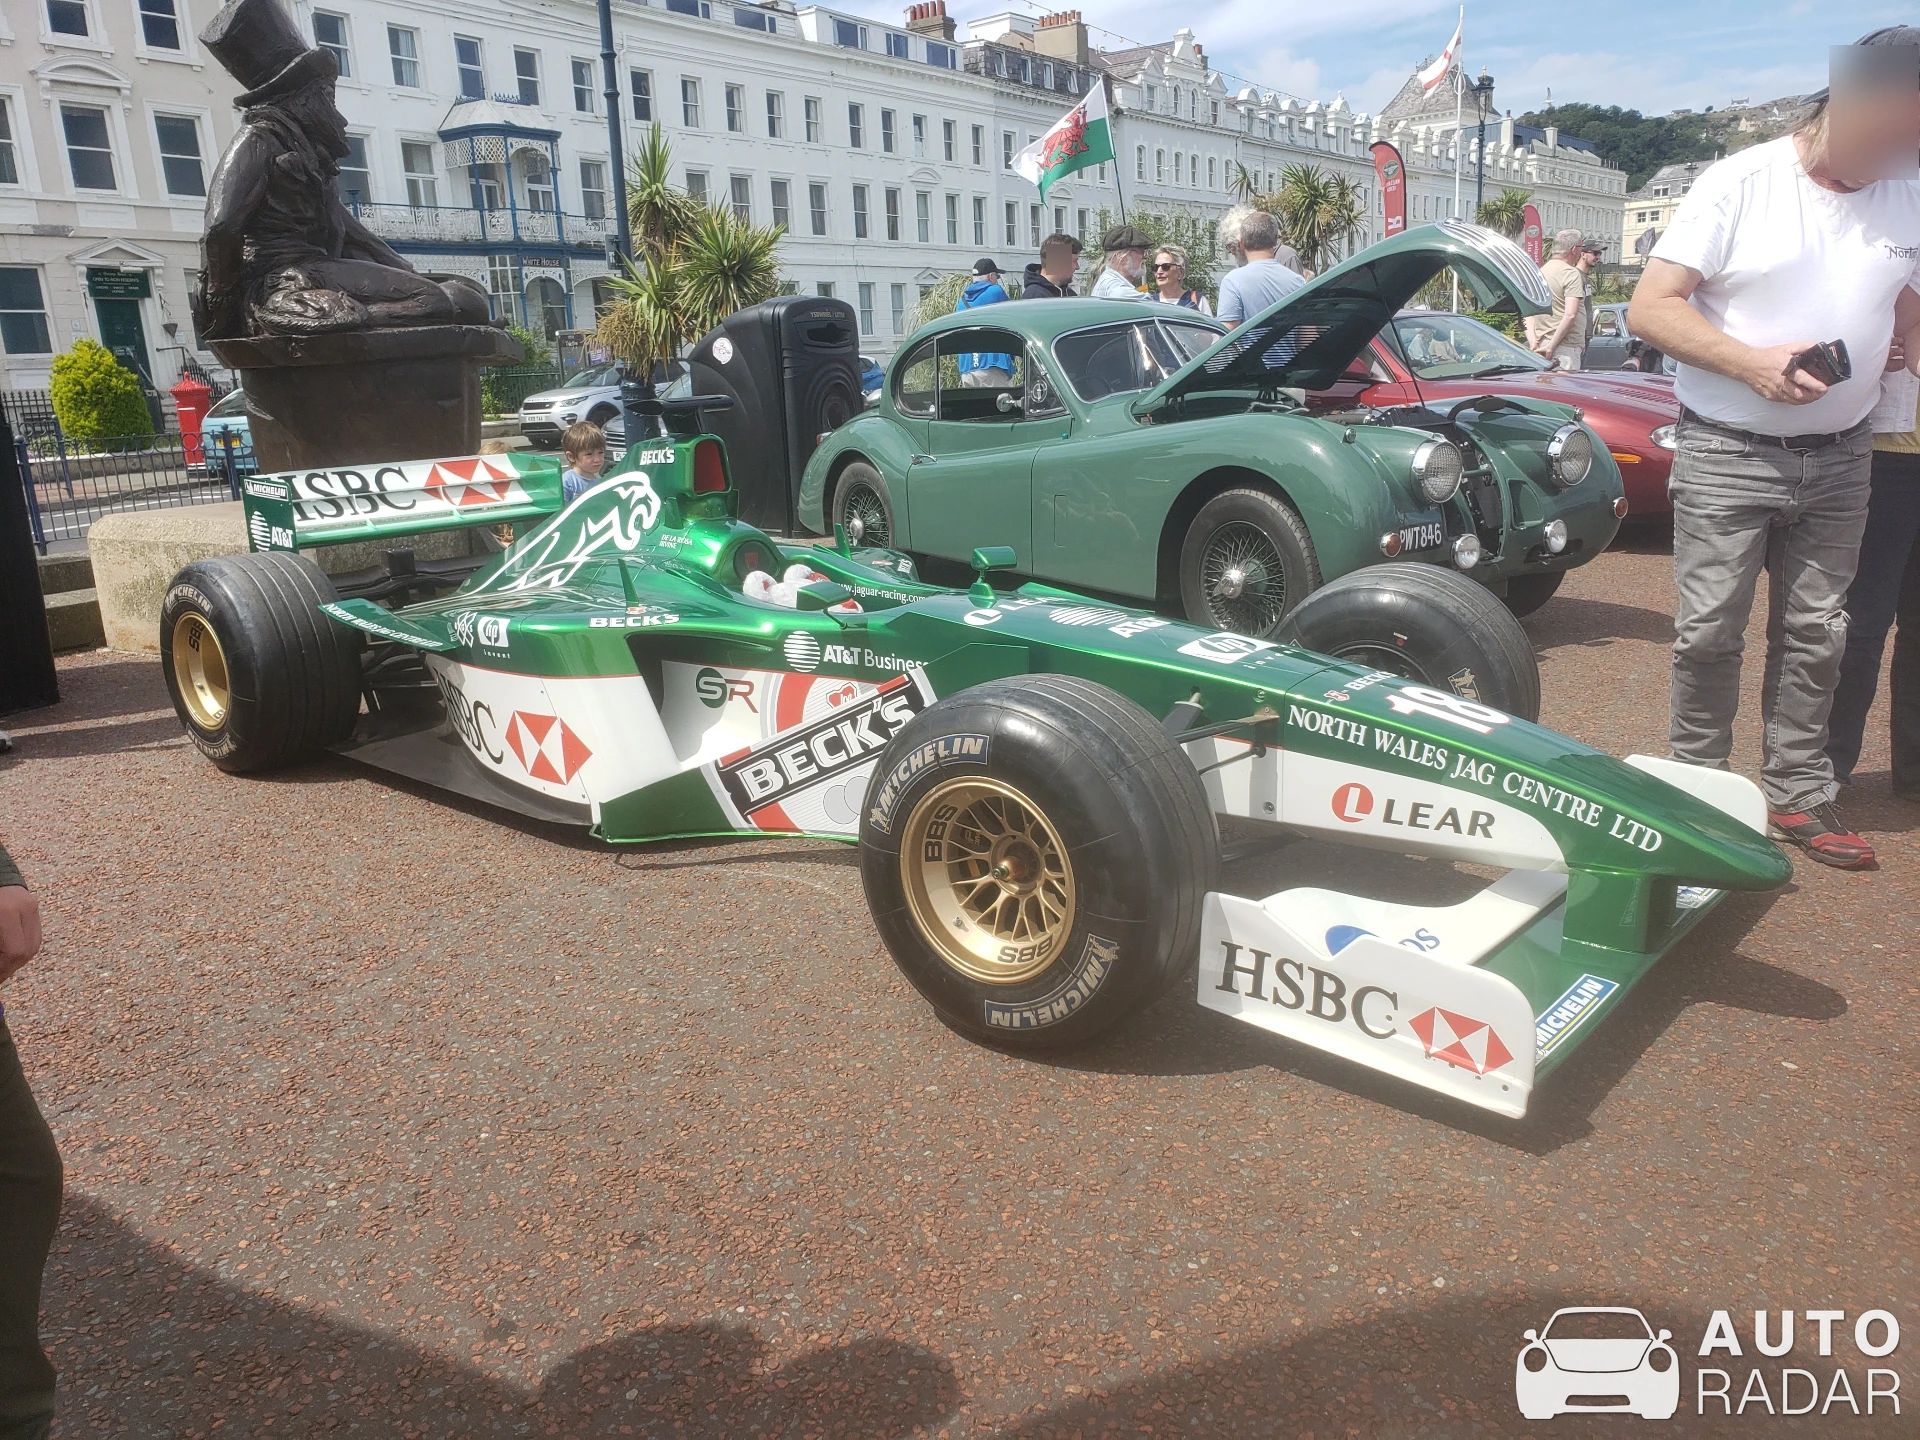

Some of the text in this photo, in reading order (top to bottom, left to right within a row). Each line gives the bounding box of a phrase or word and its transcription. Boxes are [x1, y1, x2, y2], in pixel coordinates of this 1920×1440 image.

[522, 257, 560, 267] WHITE HOUSE
[1884, 245, 1918, 261] Nort
[640, 447, 675, 466] BECK'S
[253, 484, 287, 498] MICHELIN
[271, 526, 294, 549] AT&T
[1400, 523, 1442, 551] PWT846
[167, 586, 212, 613] MICHELIN
[840, 583, 926, 604] w.jaguar-racing.co
[588, 613, 680, 628] BECK'S
[484, 649, 512, 659] invent
[823, 644, 862, 666] AT&T
[698, 676, 759, 713] SR
[1385, 685, 1512, 736] 18
[735, 695, 917, 802] BECK'S
[879, 737, 985, 815] MICHELIN
[1287, 705, 1663, 852] NORTH WALES JAG CENTRE LTD
[1382, 798, 1496, 839] LEAR
[924, 804, 958, 863] BBS
[997, 937, 1053, 965] BBS
[990, 953, 1107, 1028] MICHELIN
[1215, 940, 1399, 1040] HSBC
[1536, 978, 1605, 1048] MICHELIN
